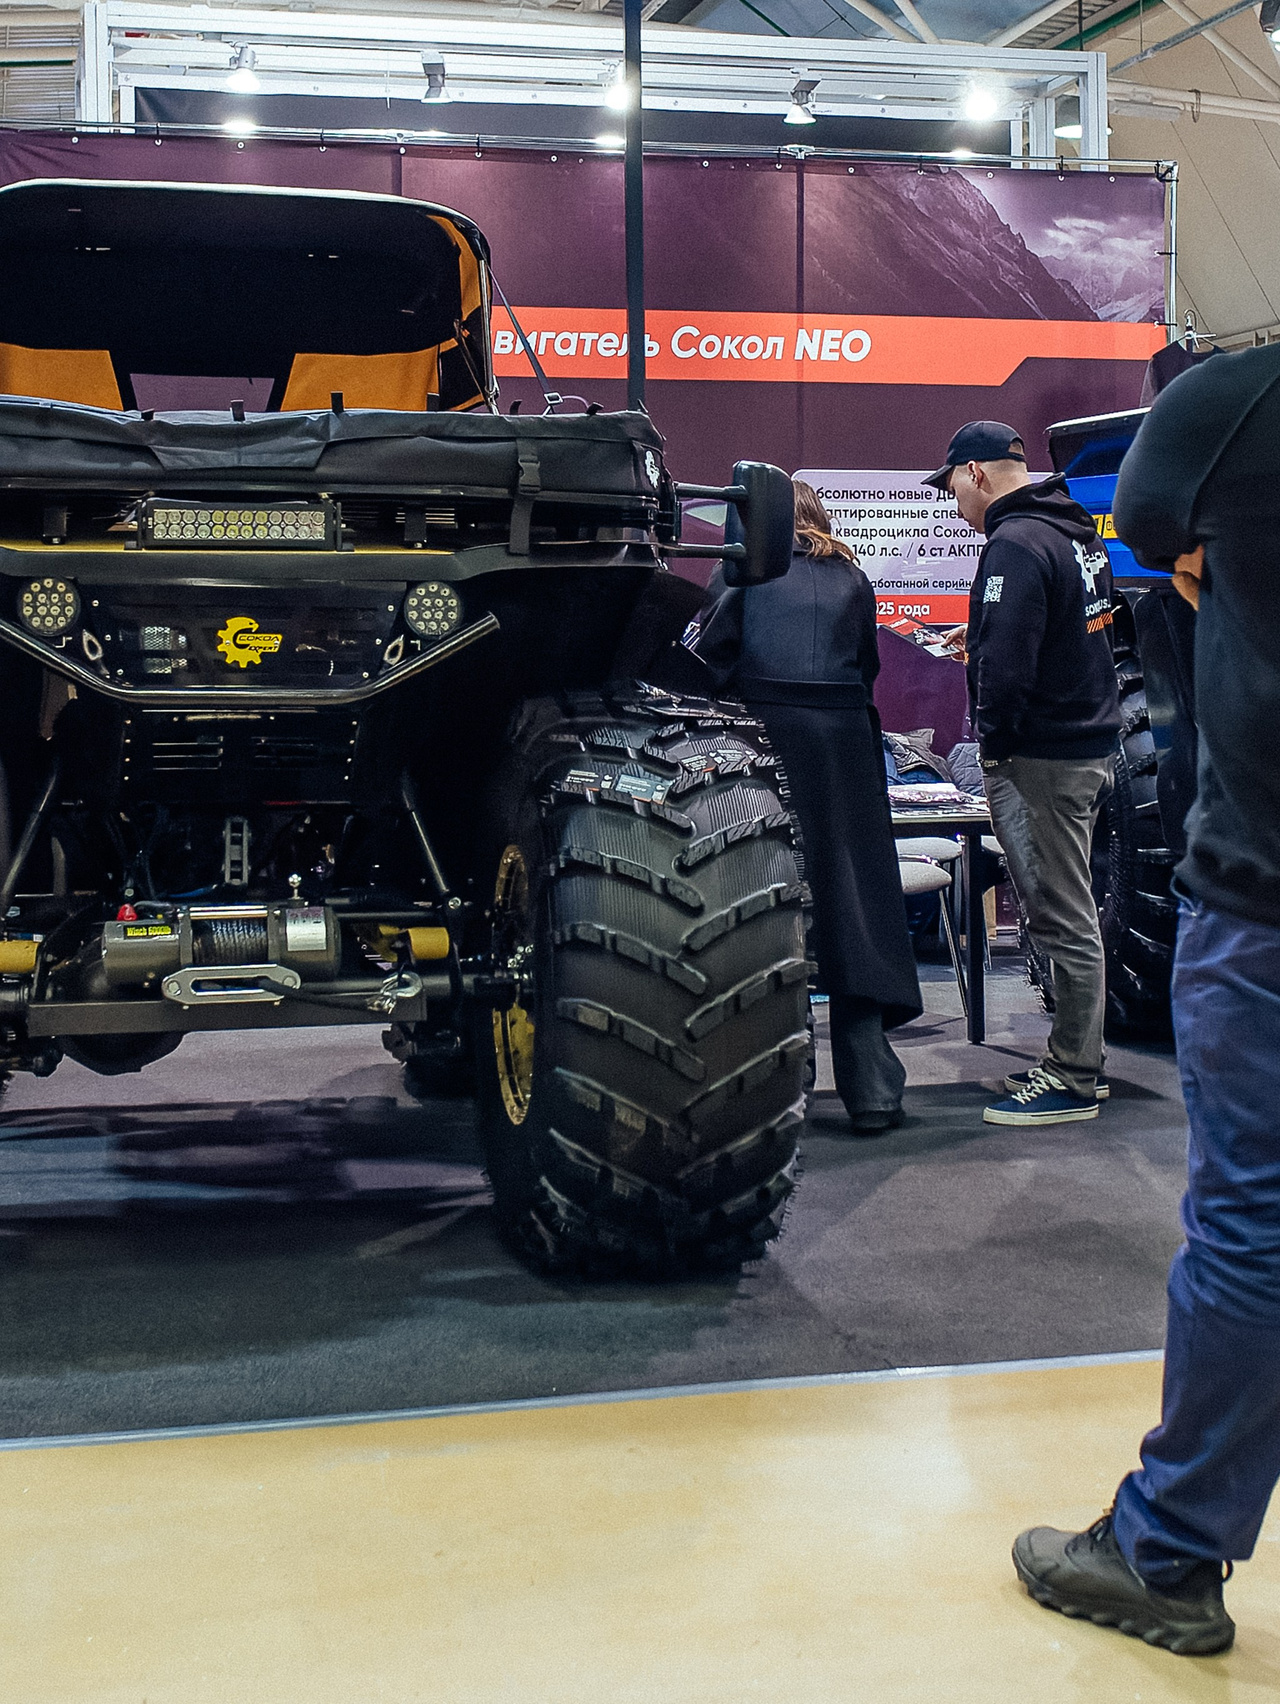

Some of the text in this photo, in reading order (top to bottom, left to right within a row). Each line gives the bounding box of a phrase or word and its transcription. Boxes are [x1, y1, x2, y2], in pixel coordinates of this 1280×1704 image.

[493, 325, 872, 362] вигатеь Сокол NEO
[816, 486, 886, 500] бсолютно
[889, 489, 932, 500] новые
[825, 508, 958, 522] аптированные спе
[835, 525, 976, 541] квадроцикла Сокол
[852, 543, 876, 556] 140
[879, 546, 902, 557] л.с.
[917, 544, 926, 557] 6
[930, 546, 945, 557] ст
[870, 577, 972, 591] аботанной серийн
[898, 604, 930, 618] года
